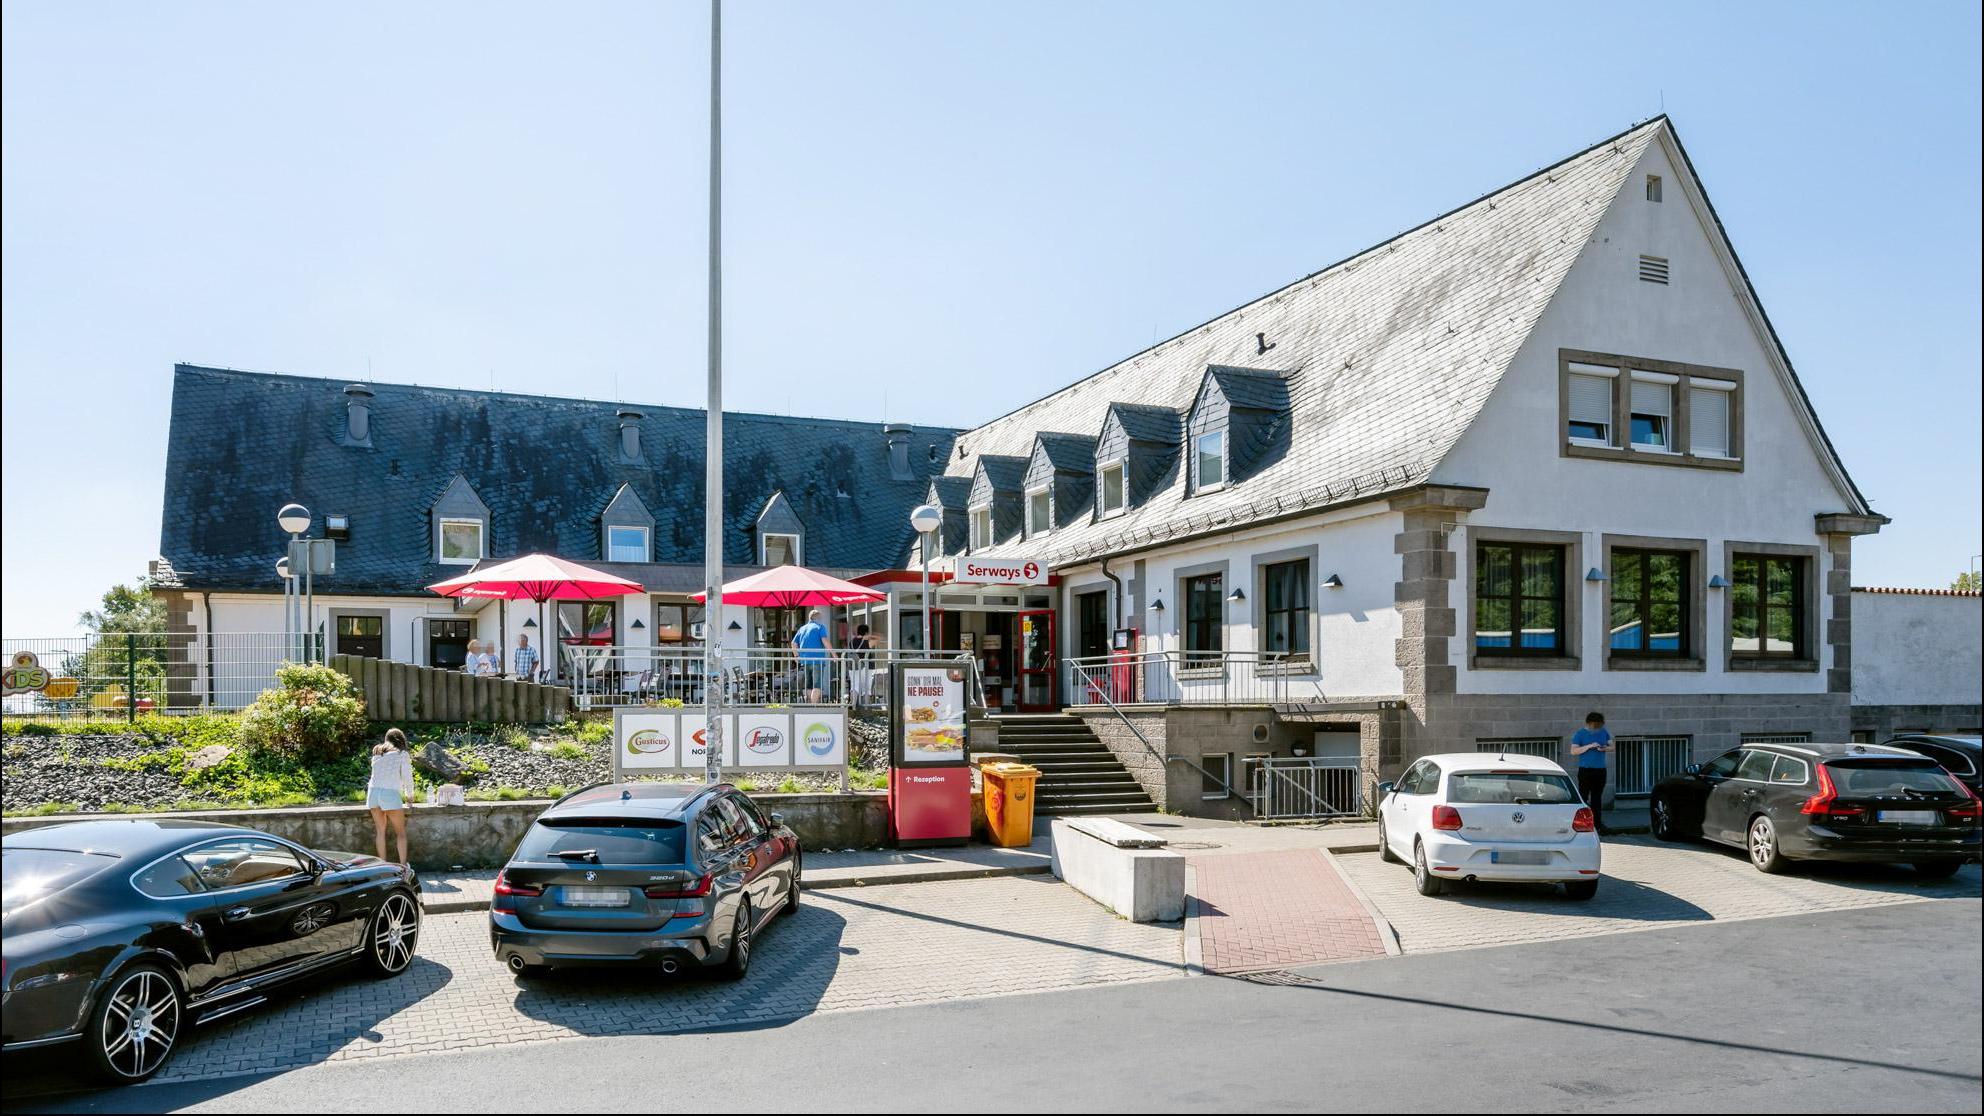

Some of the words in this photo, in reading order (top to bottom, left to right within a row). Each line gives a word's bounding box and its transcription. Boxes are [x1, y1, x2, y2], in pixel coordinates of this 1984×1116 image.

[967, 564, 1021, 580] Serways
[907, 687, 917, 696] NE
[918, 687, 944, 696] PAUSE!
[635, 736, 667, 746] Gusticus
